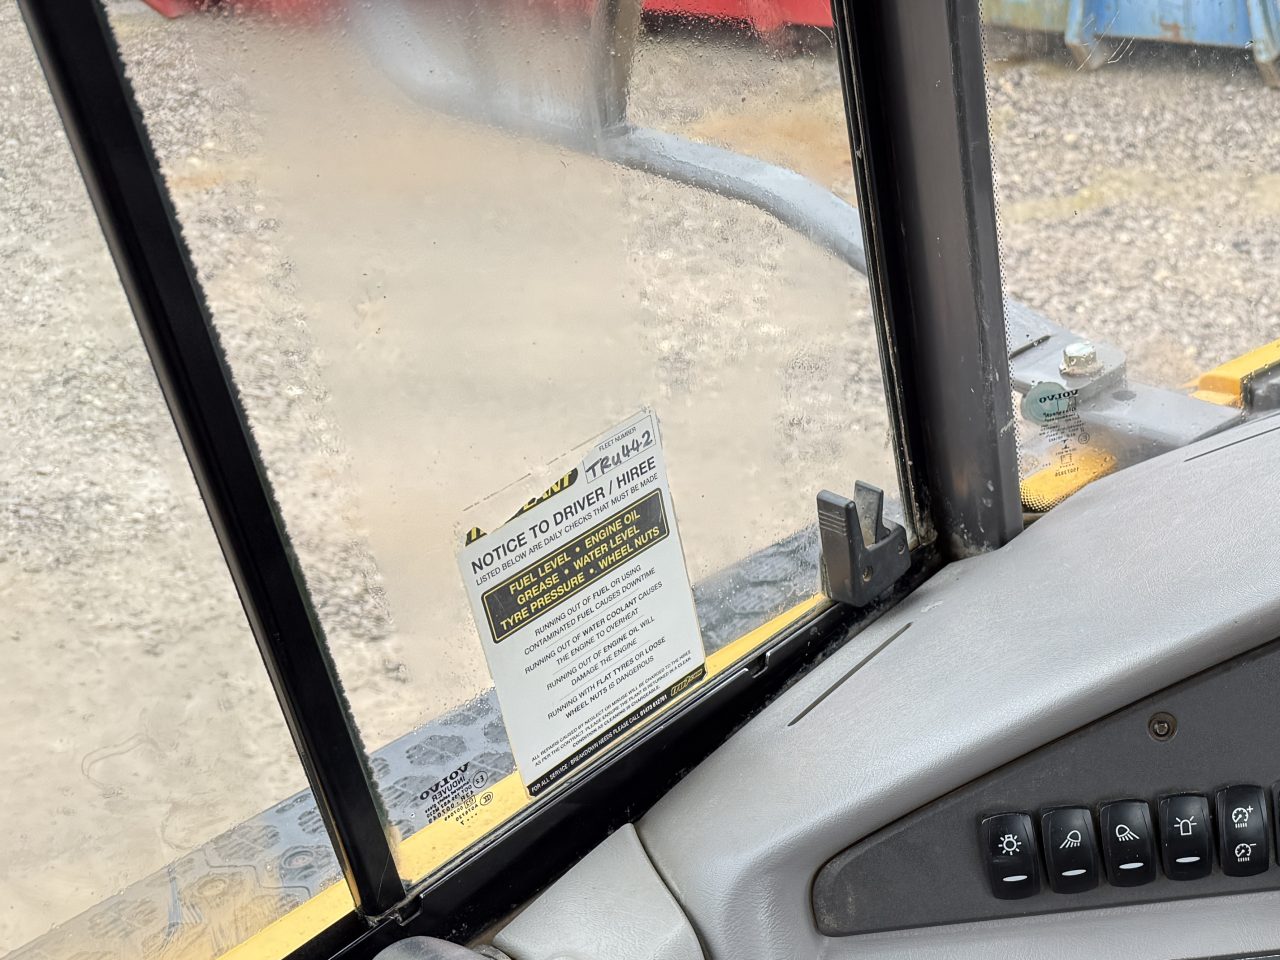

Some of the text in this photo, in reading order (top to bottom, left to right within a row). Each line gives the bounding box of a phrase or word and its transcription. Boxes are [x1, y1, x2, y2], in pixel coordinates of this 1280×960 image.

[598, 426, 636, 451] FLEET NUMBER
[471, 532, 526, 573] NOTICE
[528, 519, 549, 538] TO
[553, 486, 604, 525] DRIVER
[609, 479, 612, 494] /
[616, 456, 655, 488] HIREE
[475, 472, 657, 585] LISTED BELOW ARE DAILY CHECKS THAT MUST BE MADE
[509, 509, 640, 594] FUEL LEVEL ENGINE OIL
[500, 526, 659, 629] TYRE PRESSURE WHEEL NUTS
[517, 525, 639, 604] GREASE WATER LEVEL
[534, 564, 641, 636] RUNNING OUT OF FUEL OR USING
[524, 567, 655, 654] CONTAMINATED FUEL CAUSES DOWNTIME
[524, 581, 662, 673] RUNNING OUT OF WATER COOLANT CAUSES
[556, 607, 637, 664] THE ENGINE TO OVERHEAT
[546, 616, 654, 690] RUNNING OUT OF ENGINE OIL WILL
[547, 636, 665, 719] RUNNING WITH FLAT TYRES OR LOOSE
[565, 700, 589, 718] WHEEL
[589, 686, 607, 702] NUTS
[608, 681, 615, 689] IS
[615, 655, 653, 684] DANGEROUS
[571, 637, 636, 685] DAMAGE THE ENGINE
